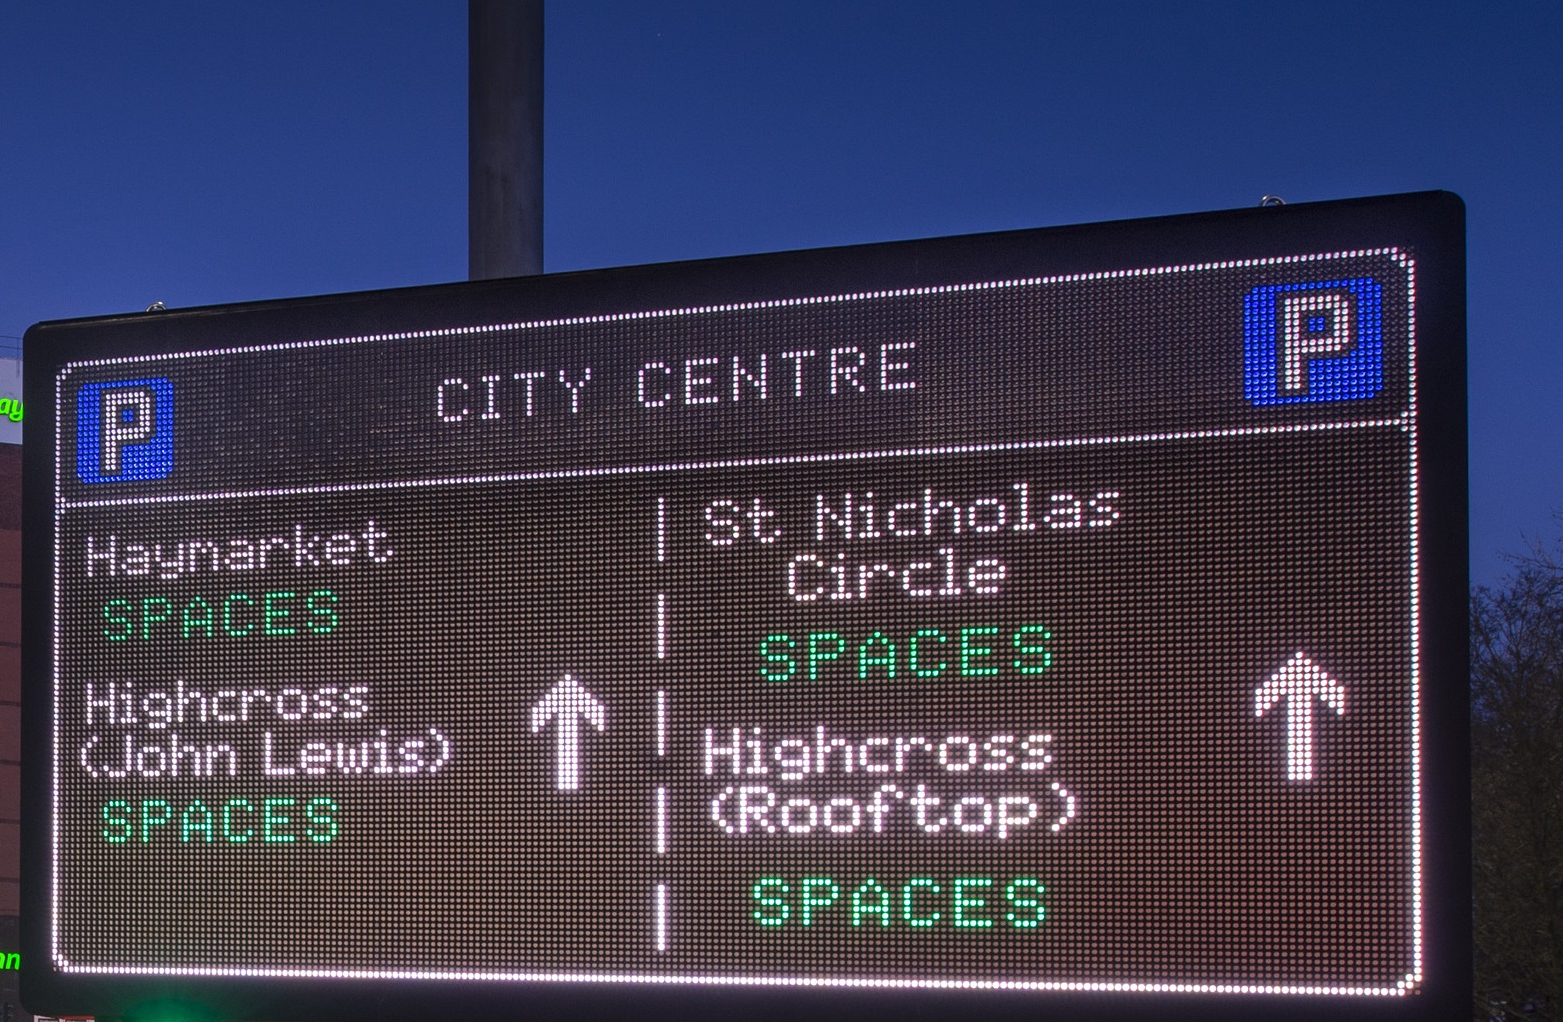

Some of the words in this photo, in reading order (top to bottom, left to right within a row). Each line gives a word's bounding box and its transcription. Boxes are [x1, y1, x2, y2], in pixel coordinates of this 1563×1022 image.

[1284, 294, 1350, 391] P
[437, 366, 592, 424] CITY
[637, 340, 918, 409] CENTRE
[104, 390, 152, 472] P
[704, 496, 783, 546] St
[816, 481, 1121, 541] Nicholas
[86, 519, 395, 580] Haymarket
[787, 546, 1007, 602] Circle
[103, 589, 338, 642] SPACES
[759, 624, 1053, 682] SPACES
[86, 679, 370, 730] Highcross
[81, 732, 237, 778] (John
[264, 727, 452, 775] Lewis)
[704, 725, 1053, 781] Highcross
[102, 799, 338, 843] SPACES
[711, 781, 1077, 840] (Rooftop)
[752, 877, 1046, 928] SPACES
